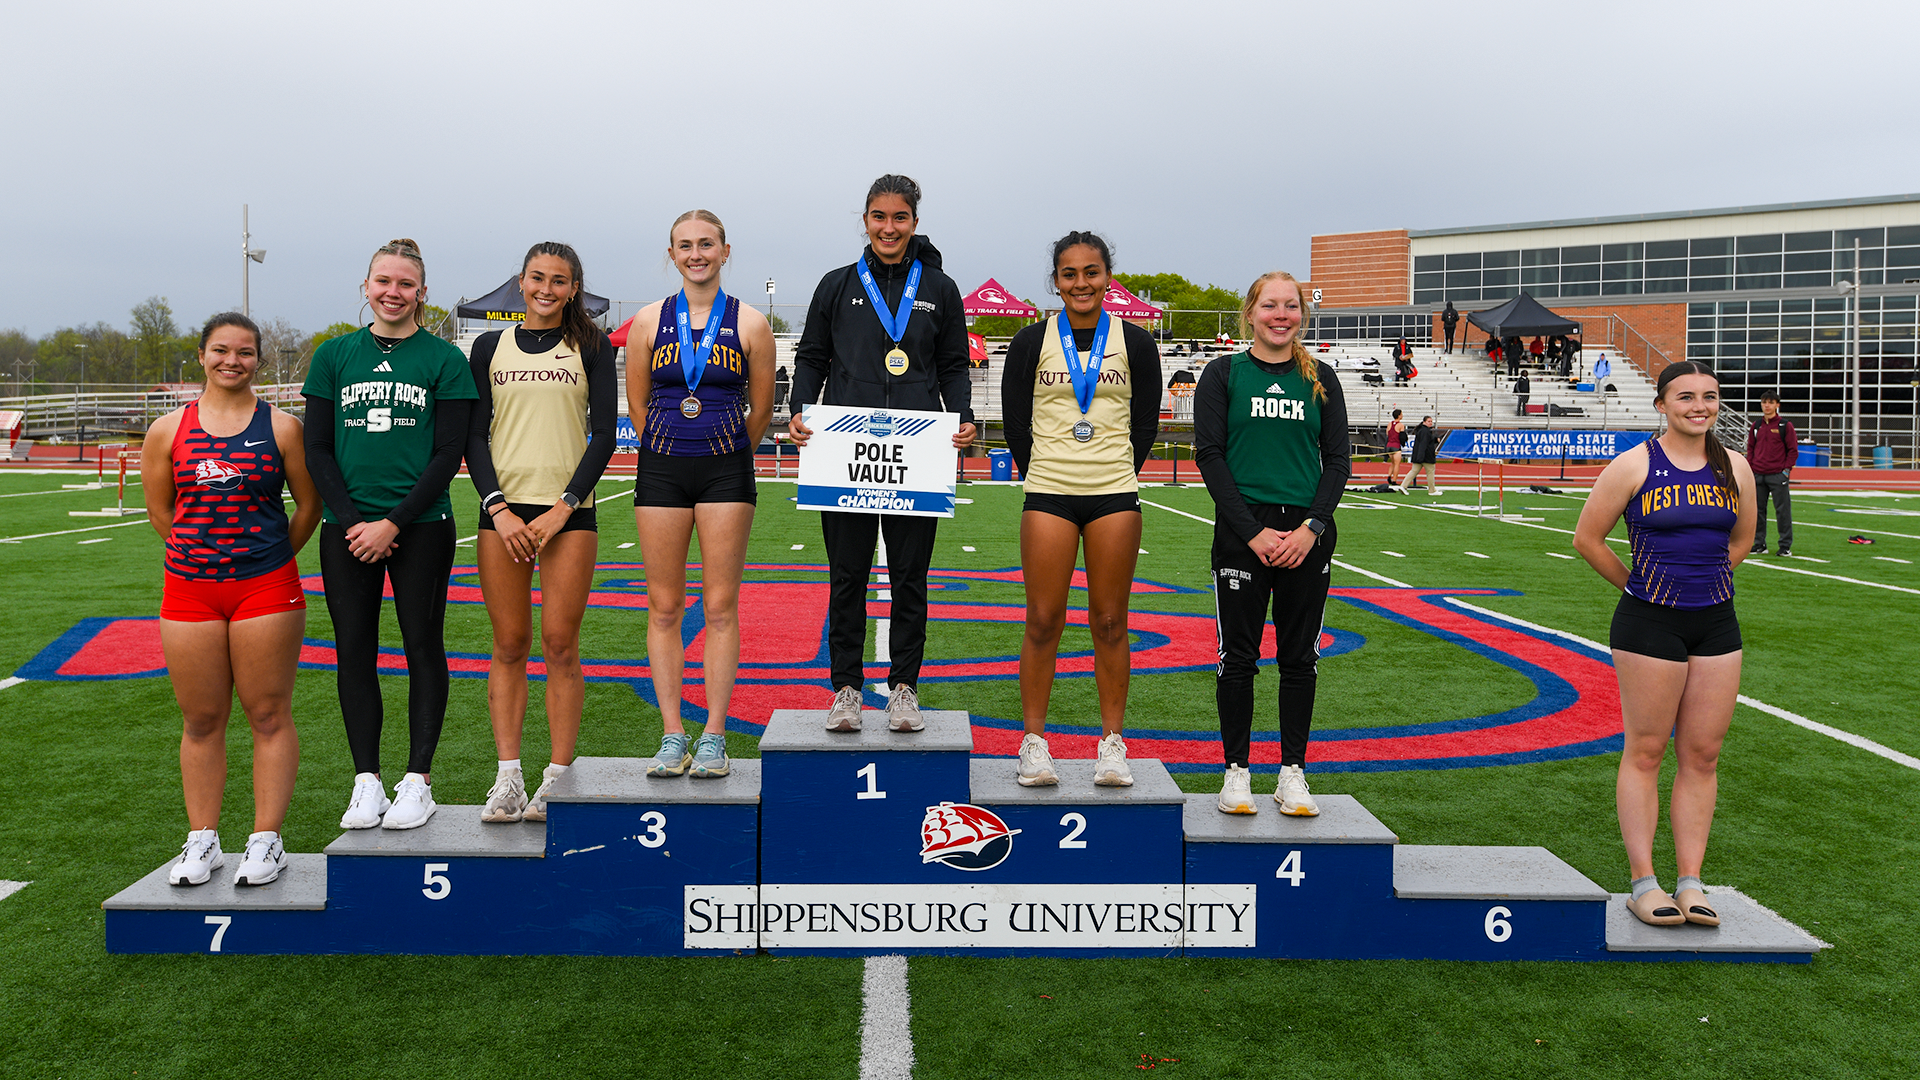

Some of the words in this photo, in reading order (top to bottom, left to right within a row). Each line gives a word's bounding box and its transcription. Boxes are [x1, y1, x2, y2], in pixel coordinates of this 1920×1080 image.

[766, 281, 775, 293] F
[1312, 290, 1322, 301] G
[652, 341, 680, 372] WEST
[493, 368, 580, 386] KUTZTOWN
[341, 381, 393, 408] SLIPPERY
[394, 382, 427, 408] ROCK
[342, 400, 426, 413] UNIVERSITY
[366, 407, 392, 433] S
[1250, 396, 1305, 421] ROCK
[344, 418, 366, 428] TRACK
[393, 418, 416, 427] FIELD
[1472, 444, 1531, 455] ATHLETIC
[1535, 444, 1615, 456] CONFERENCE
[1473, 433, 1571, 445] PENNSYLVANIA
[1577, 433, 1615, 445] STATE
[854, 442, 904, 463] POLE
[848, 463, 908, 484] VAULT
[837, 494, 914, 511] CHAMPION
[856, 488, 897, 498] WOMEN'S
[1641, 484, 1681, 517] WEST
[1686, 484, 1739, 516] CHESTE
[1229, 578, 1240, 590] S
[856, 763, 887, 800] 1
[637, 811, 667, 849] 3
[1059, 812, 1087, 849] 2
[1275, 850, 1306, 887] 4
[422, 863, 452, 900] 5
[688, 897, 988, 934] SHIPPENSBURG
[1009, 902, 1251, 934] UNIVERSITY
[1484, 905, 1513, 943] 6
[204, 915, 232, 952] 7
